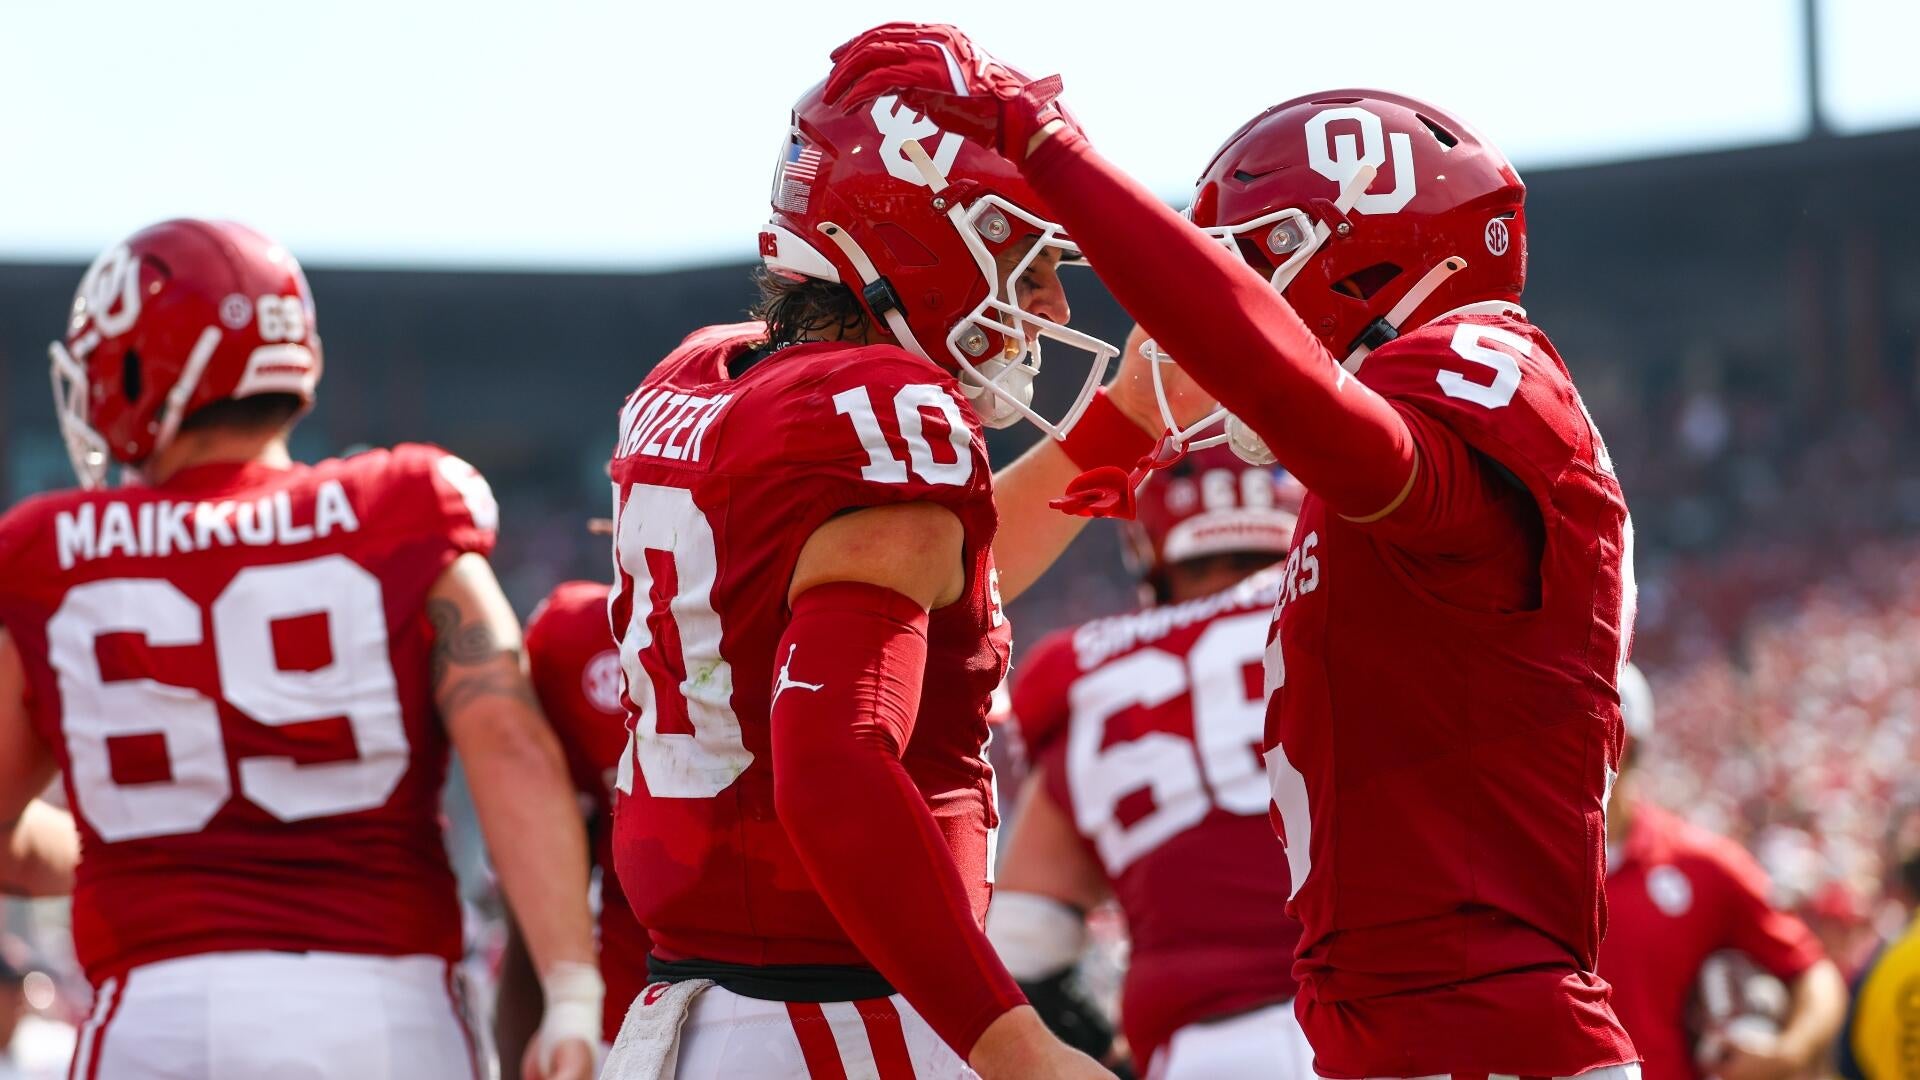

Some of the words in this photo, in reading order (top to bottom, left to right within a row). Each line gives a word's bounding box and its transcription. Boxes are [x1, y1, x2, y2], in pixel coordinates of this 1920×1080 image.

[1304, 107, 1417, 215] OU
[1488, 221, 1507, 252] SEC
[256, 294, 305, 342] 69
[1436, 323, 1532, 409] 5
[832, 384, 972, 486] 10
[56, 481, 359, 570] MAIKKULA
[47, 554, 411, 843] 69
[1067, 612, 1272, 876] 66
